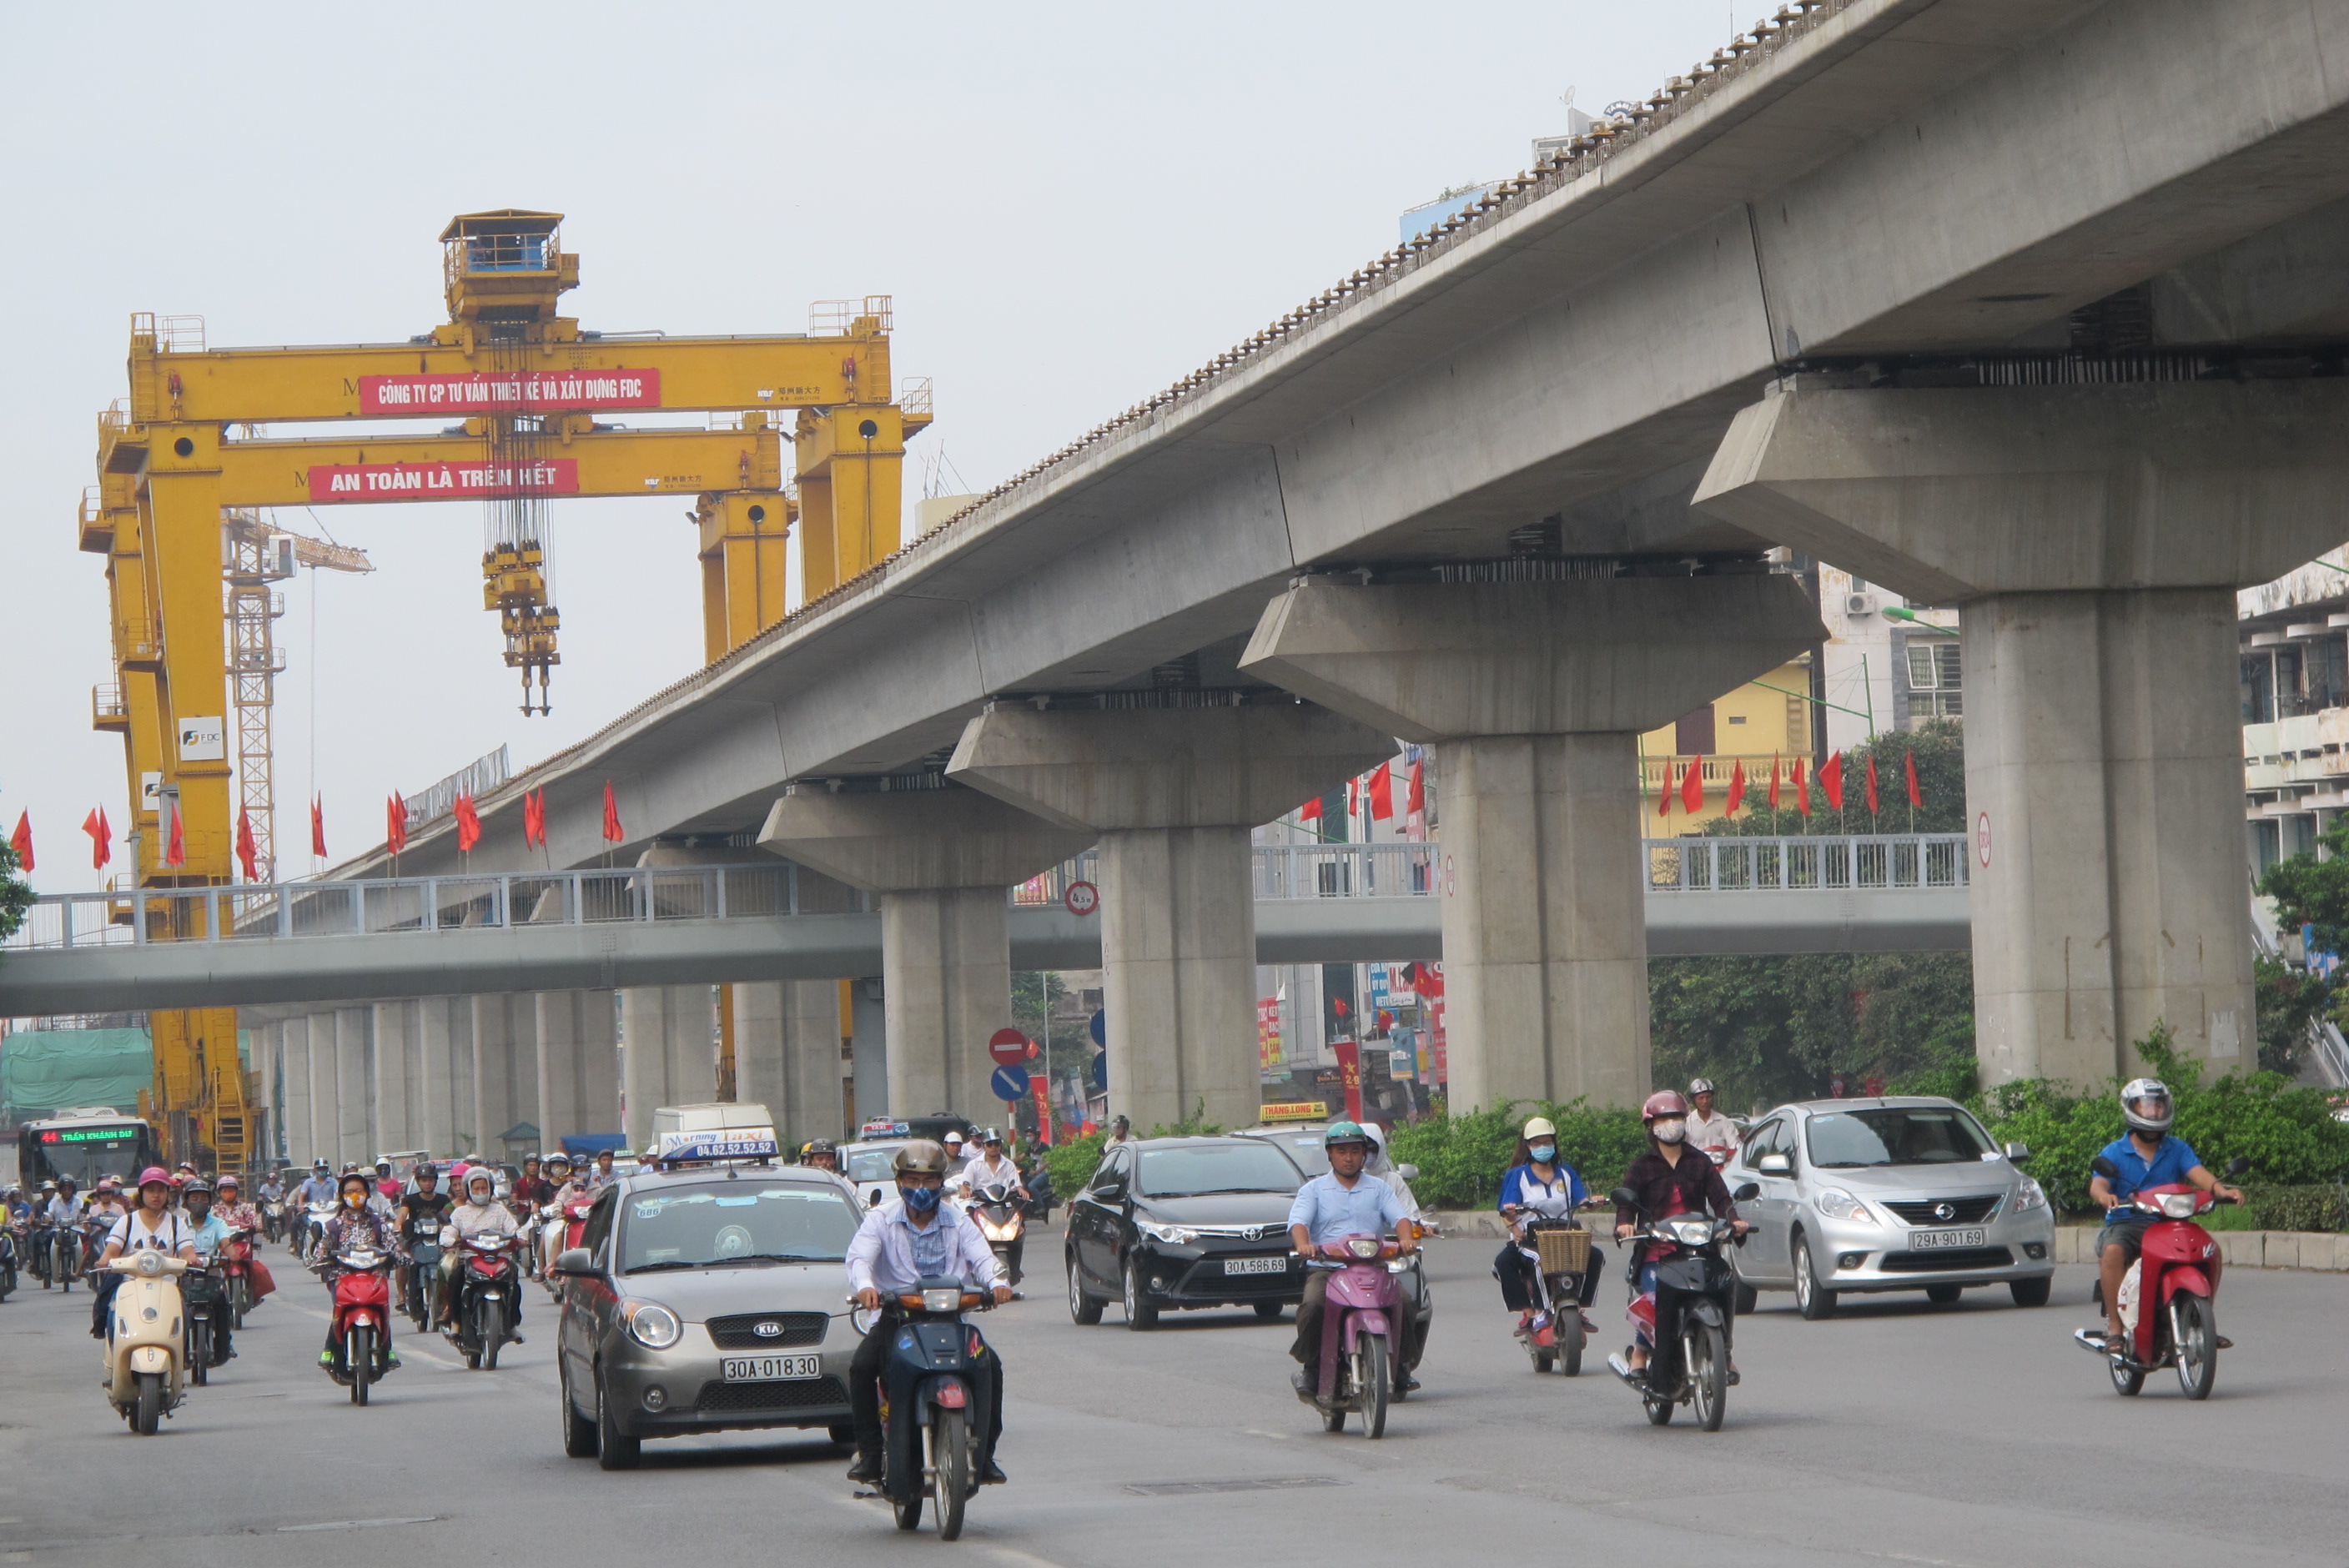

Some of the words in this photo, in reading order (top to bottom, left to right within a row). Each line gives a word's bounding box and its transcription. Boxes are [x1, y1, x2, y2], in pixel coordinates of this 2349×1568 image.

[378, 379, 410, 405] CÔNG
[413, 384, 426, 403] TY
[429, 384, 445, 403] CP
[447, 381, 463, 402] TƯ
[465, 374, 488, 402] VẤN
[490, 373, 521, 401] THIẾT
[525, 373, 540, 400] KẾ
[542, 376, 558, 400] VÀ
[560, 374, 583, 400] XÂY
[586, 378, 617, 401] DỰNG
[620, 378, 642, 398] FDC
[330, 473, 360, 491] AN
[366, 468, 421, 490] TOÀN
[427, 465, 454, 489] LÀ
[459, 465, 511, 487] TRÊN
[519, 460, 556, 485] HẾT
[42, 1132, 58, 1142] 44
[697, 1142, 772, 1157] 04.62.52.52.52
[640, 1208, 659, 1217] 686
[1916, 1231, 1982, 1248] 29A-901.69
[1226, 1259, 1285, 1274] 30A-586.69
[758, 1324, 779, 1334] KIA
[727, 1357, 817, 1379] 30A-018.30
